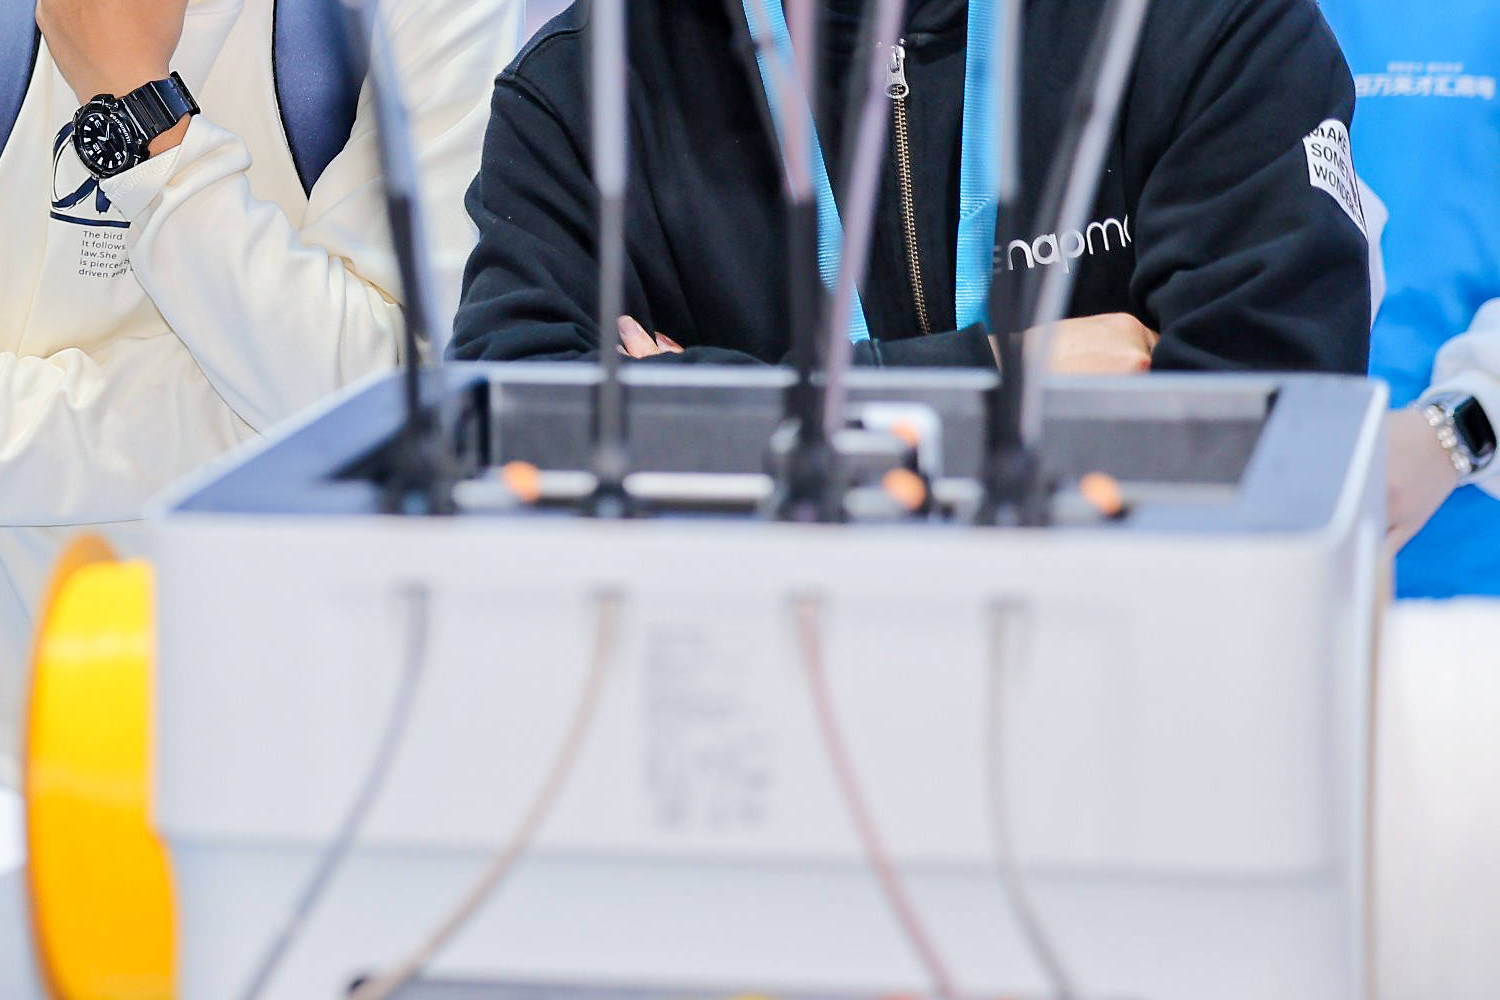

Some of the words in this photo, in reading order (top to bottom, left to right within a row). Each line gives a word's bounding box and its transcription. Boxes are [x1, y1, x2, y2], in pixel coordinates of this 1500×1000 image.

[83, 230, 101, 239] The
[103, 231, 123, 241] bird
[92, 241, 126, 250] follows
[994, 214, 1132, 274] napm
[79, 258, 87, 266] is
[78, 268, 109, 278] driven
